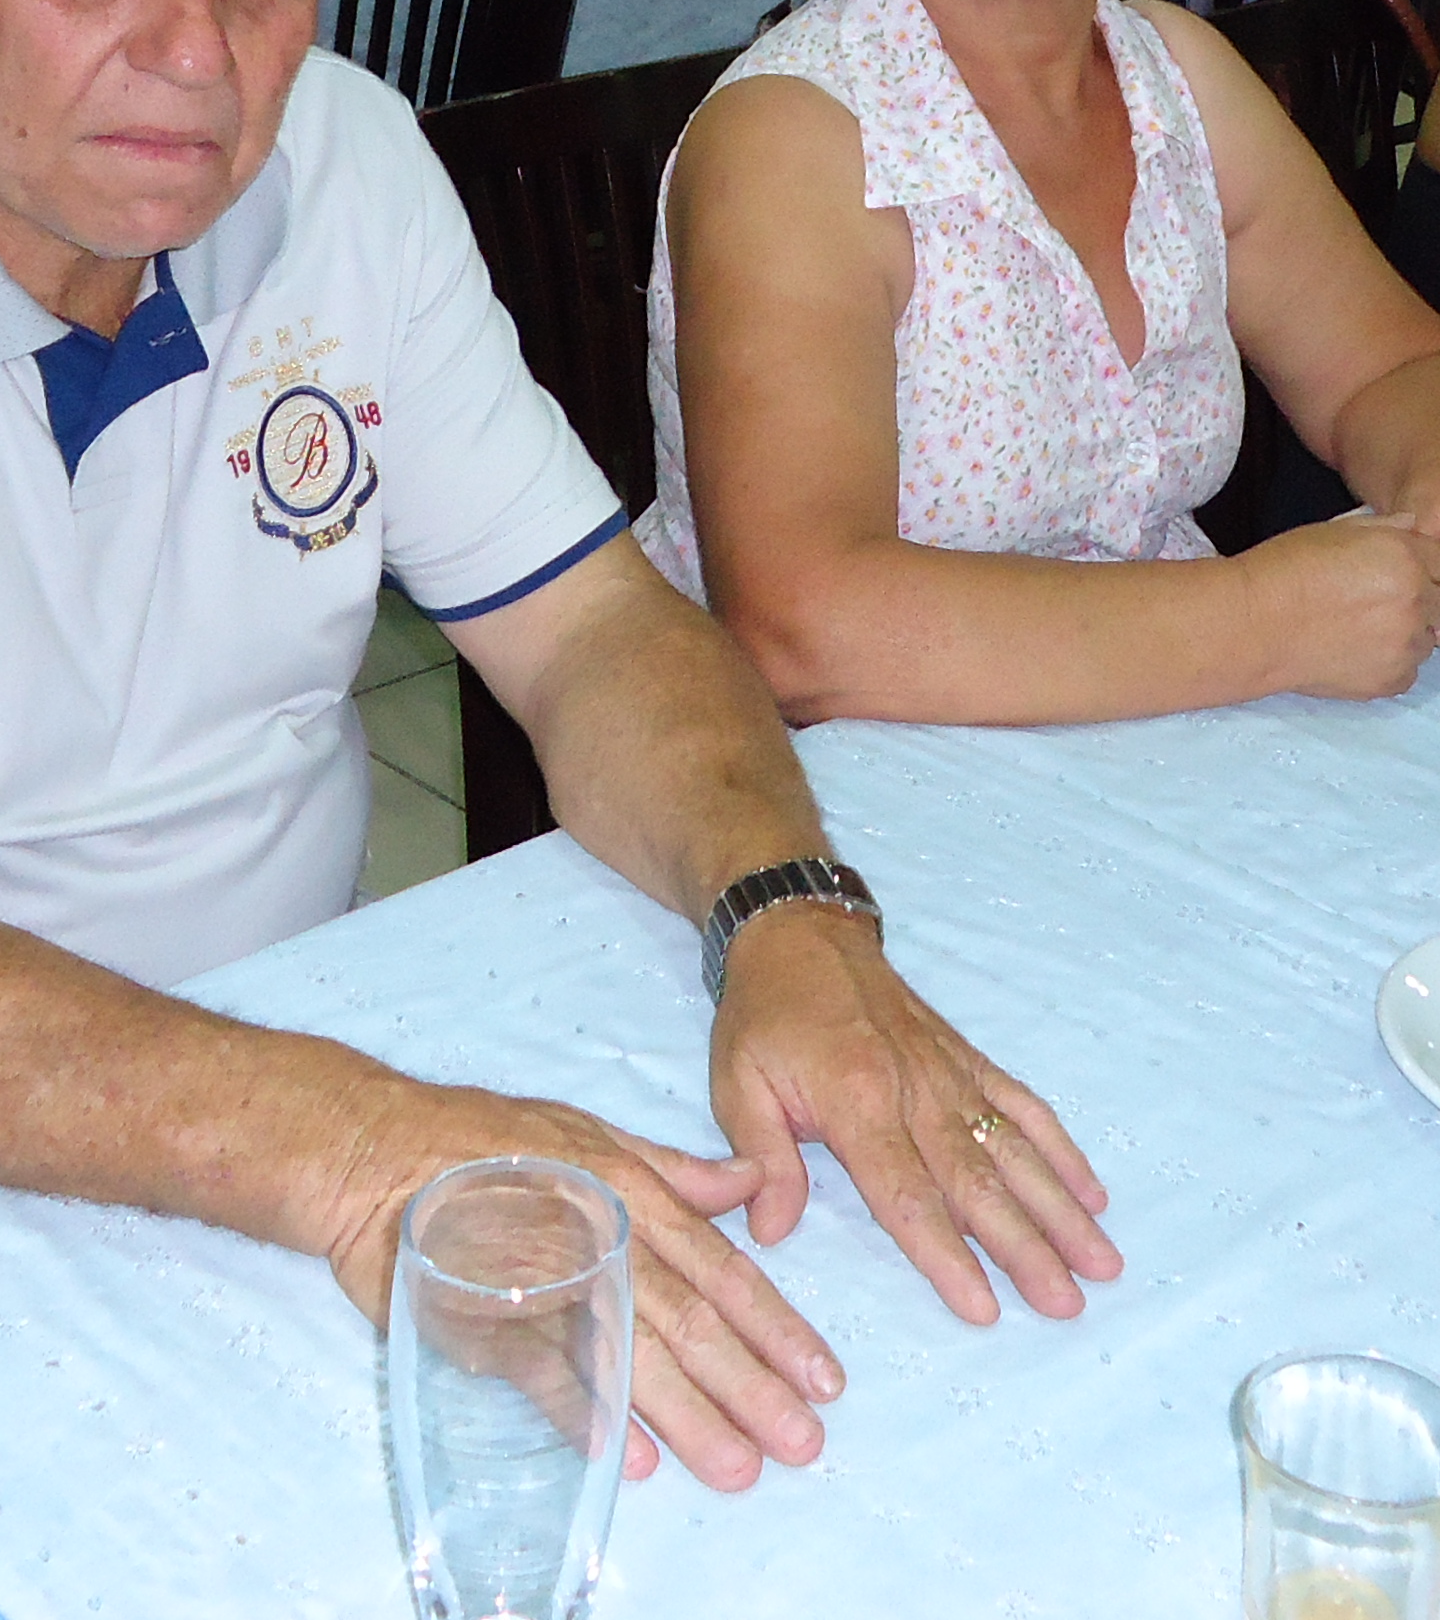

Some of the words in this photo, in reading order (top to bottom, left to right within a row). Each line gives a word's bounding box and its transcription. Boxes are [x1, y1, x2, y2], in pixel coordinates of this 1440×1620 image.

[353, 400, 383, 430] 48
[226, 448, 252, 480] 19
[282, 410, 329, 490] B
